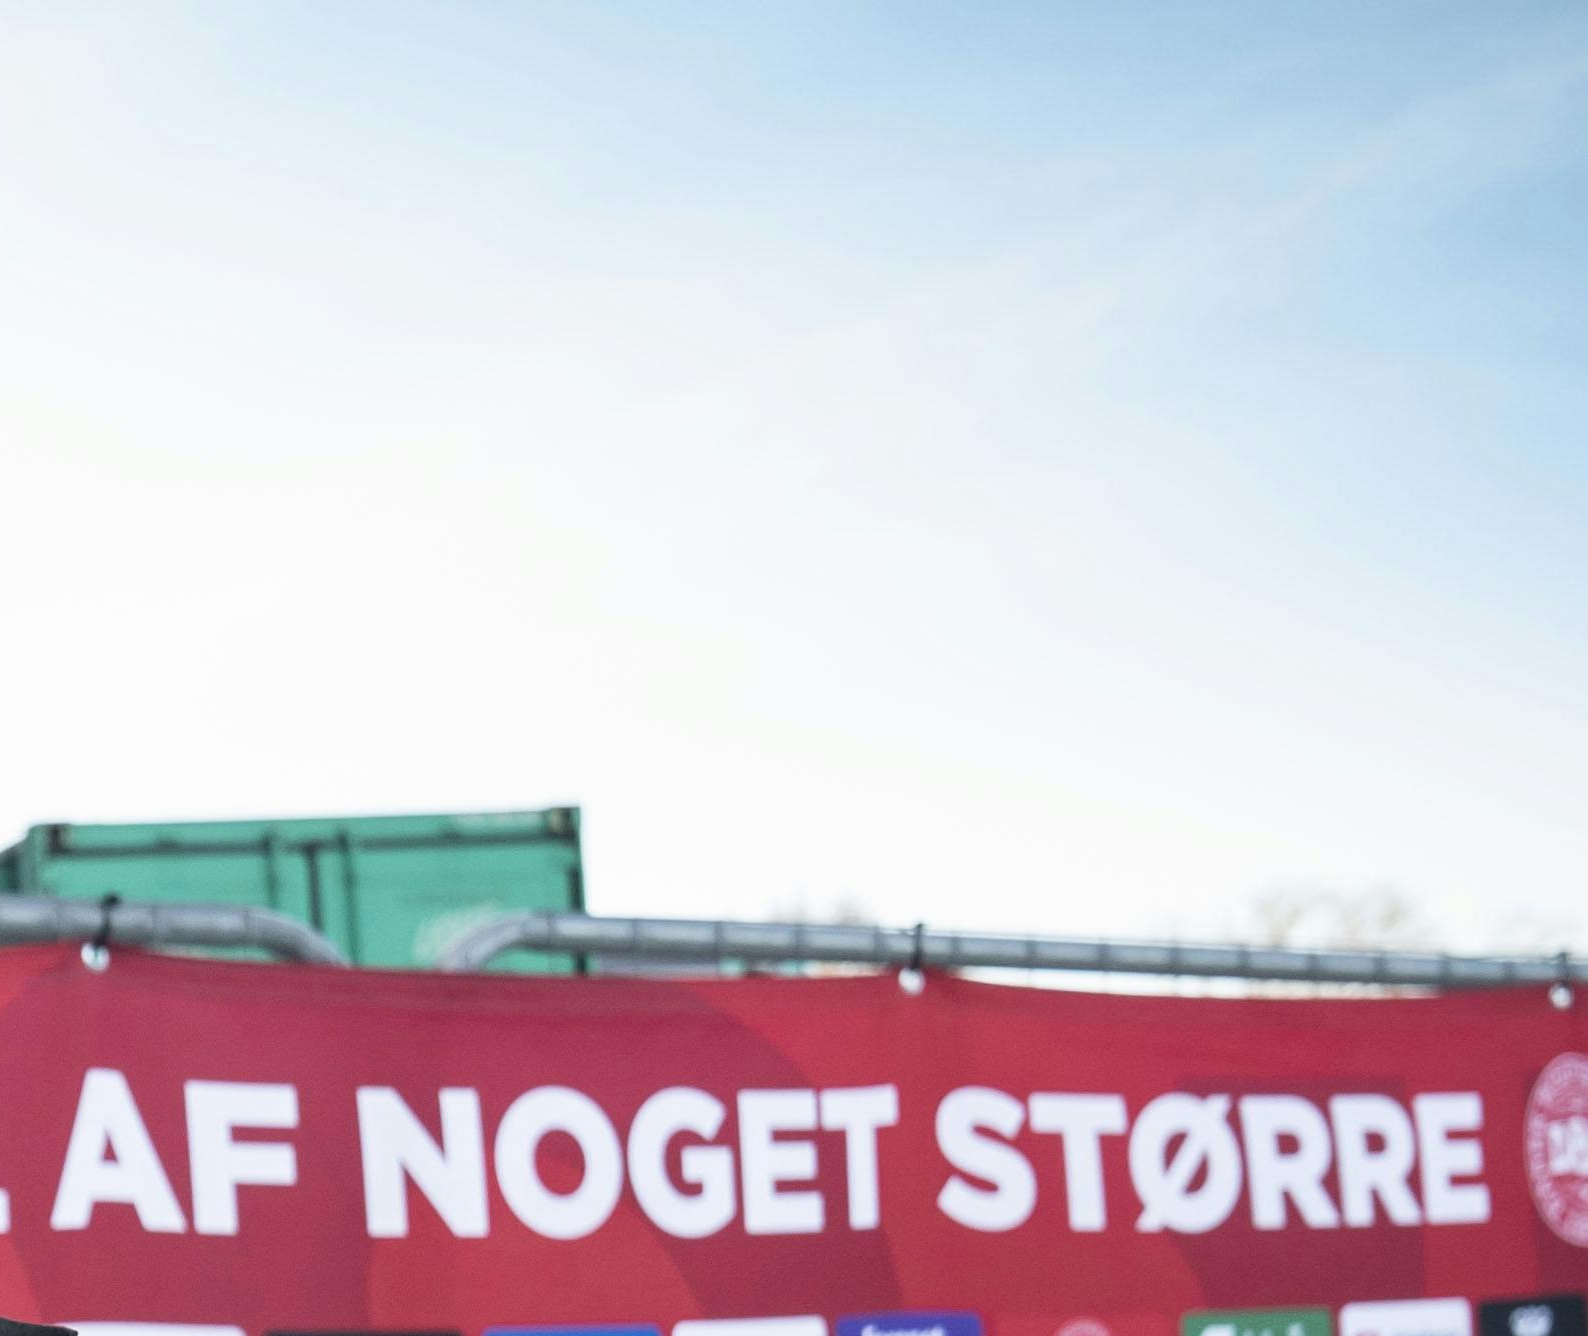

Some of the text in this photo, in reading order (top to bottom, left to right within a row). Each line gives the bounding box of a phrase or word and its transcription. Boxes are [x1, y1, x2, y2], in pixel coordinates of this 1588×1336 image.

[49, 1066, 298, 1237] AF
[356, 1084, 898, 1240] NOGET
[935, 1090, 1491, 1234] STØRRE
